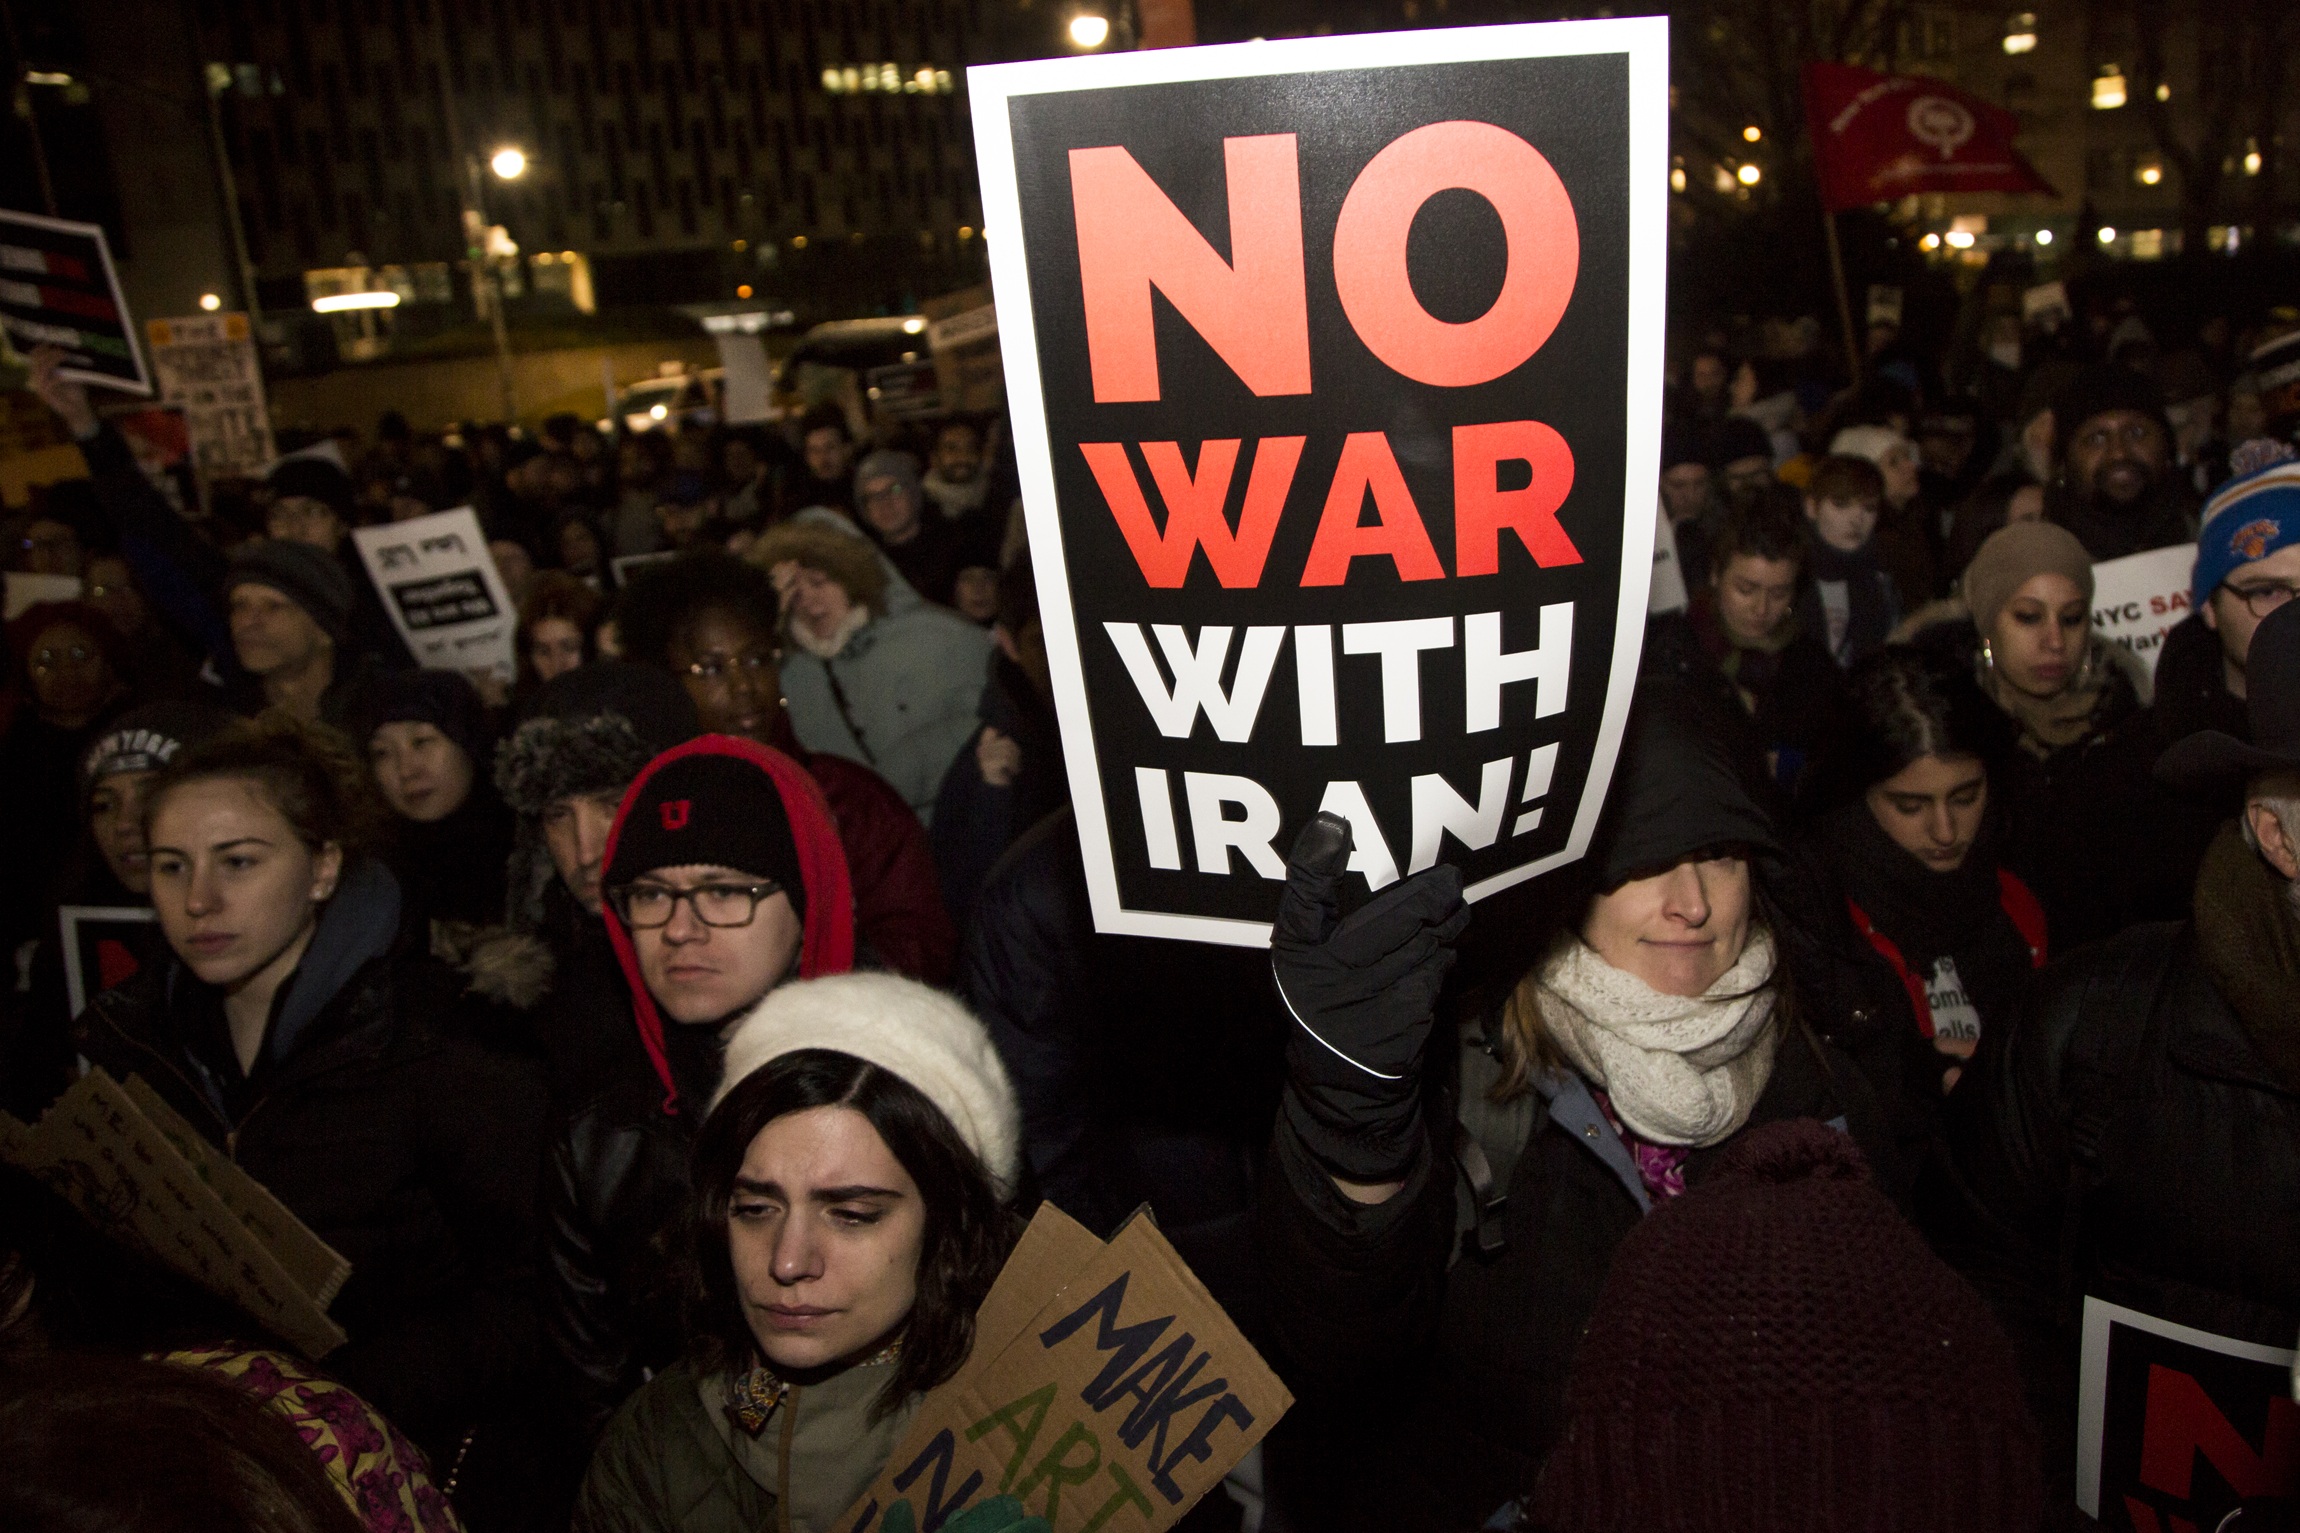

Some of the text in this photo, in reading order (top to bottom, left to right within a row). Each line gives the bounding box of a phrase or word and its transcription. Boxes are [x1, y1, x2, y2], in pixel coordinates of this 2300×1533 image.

[1068, 120, 1580, 404] NO
[1078, 419, 1584, 589] WAR
[1102, 601, 1575, 746] WITH
[2091, 601, 2142, 628] NYC
[1135, 741, 1560, 892] IRAN!
[965, 1382, 1154, 1533] ART
[1039, 1270, 1255, 1506] MAKE
